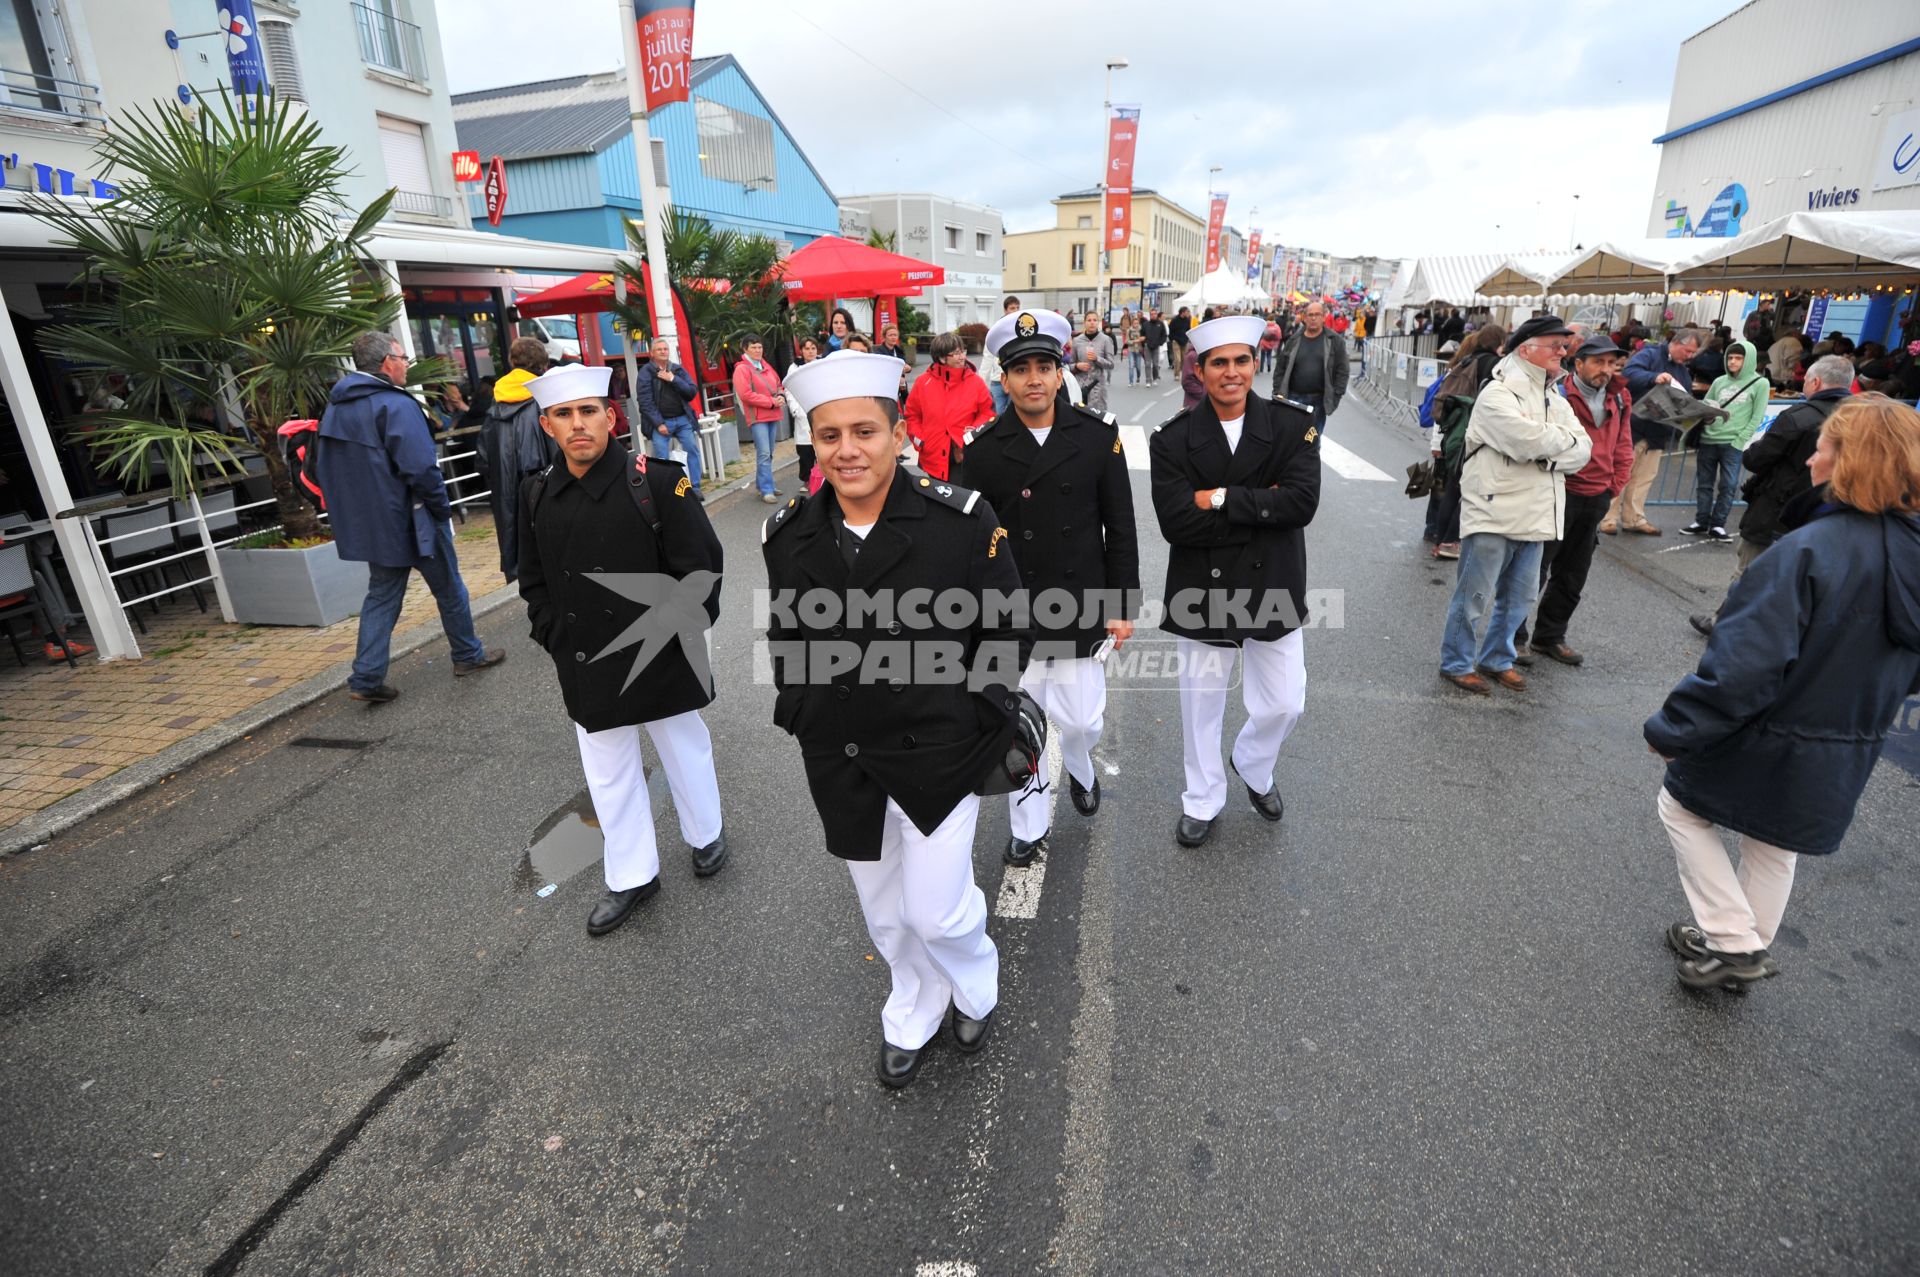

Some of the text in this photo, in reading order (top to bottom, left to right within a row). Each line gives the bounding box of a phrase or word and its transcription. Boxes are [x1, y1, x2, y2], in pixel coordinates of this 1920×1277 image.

[644, 24, 654, 36] Du
[656, 18, 668, 30] 13
[671, 18, 684, 28] au
[455, 155, 479, 180] illy
[487, 171, 499, 212] TABAC
[1808, 186, 1860, 210] Viviers
